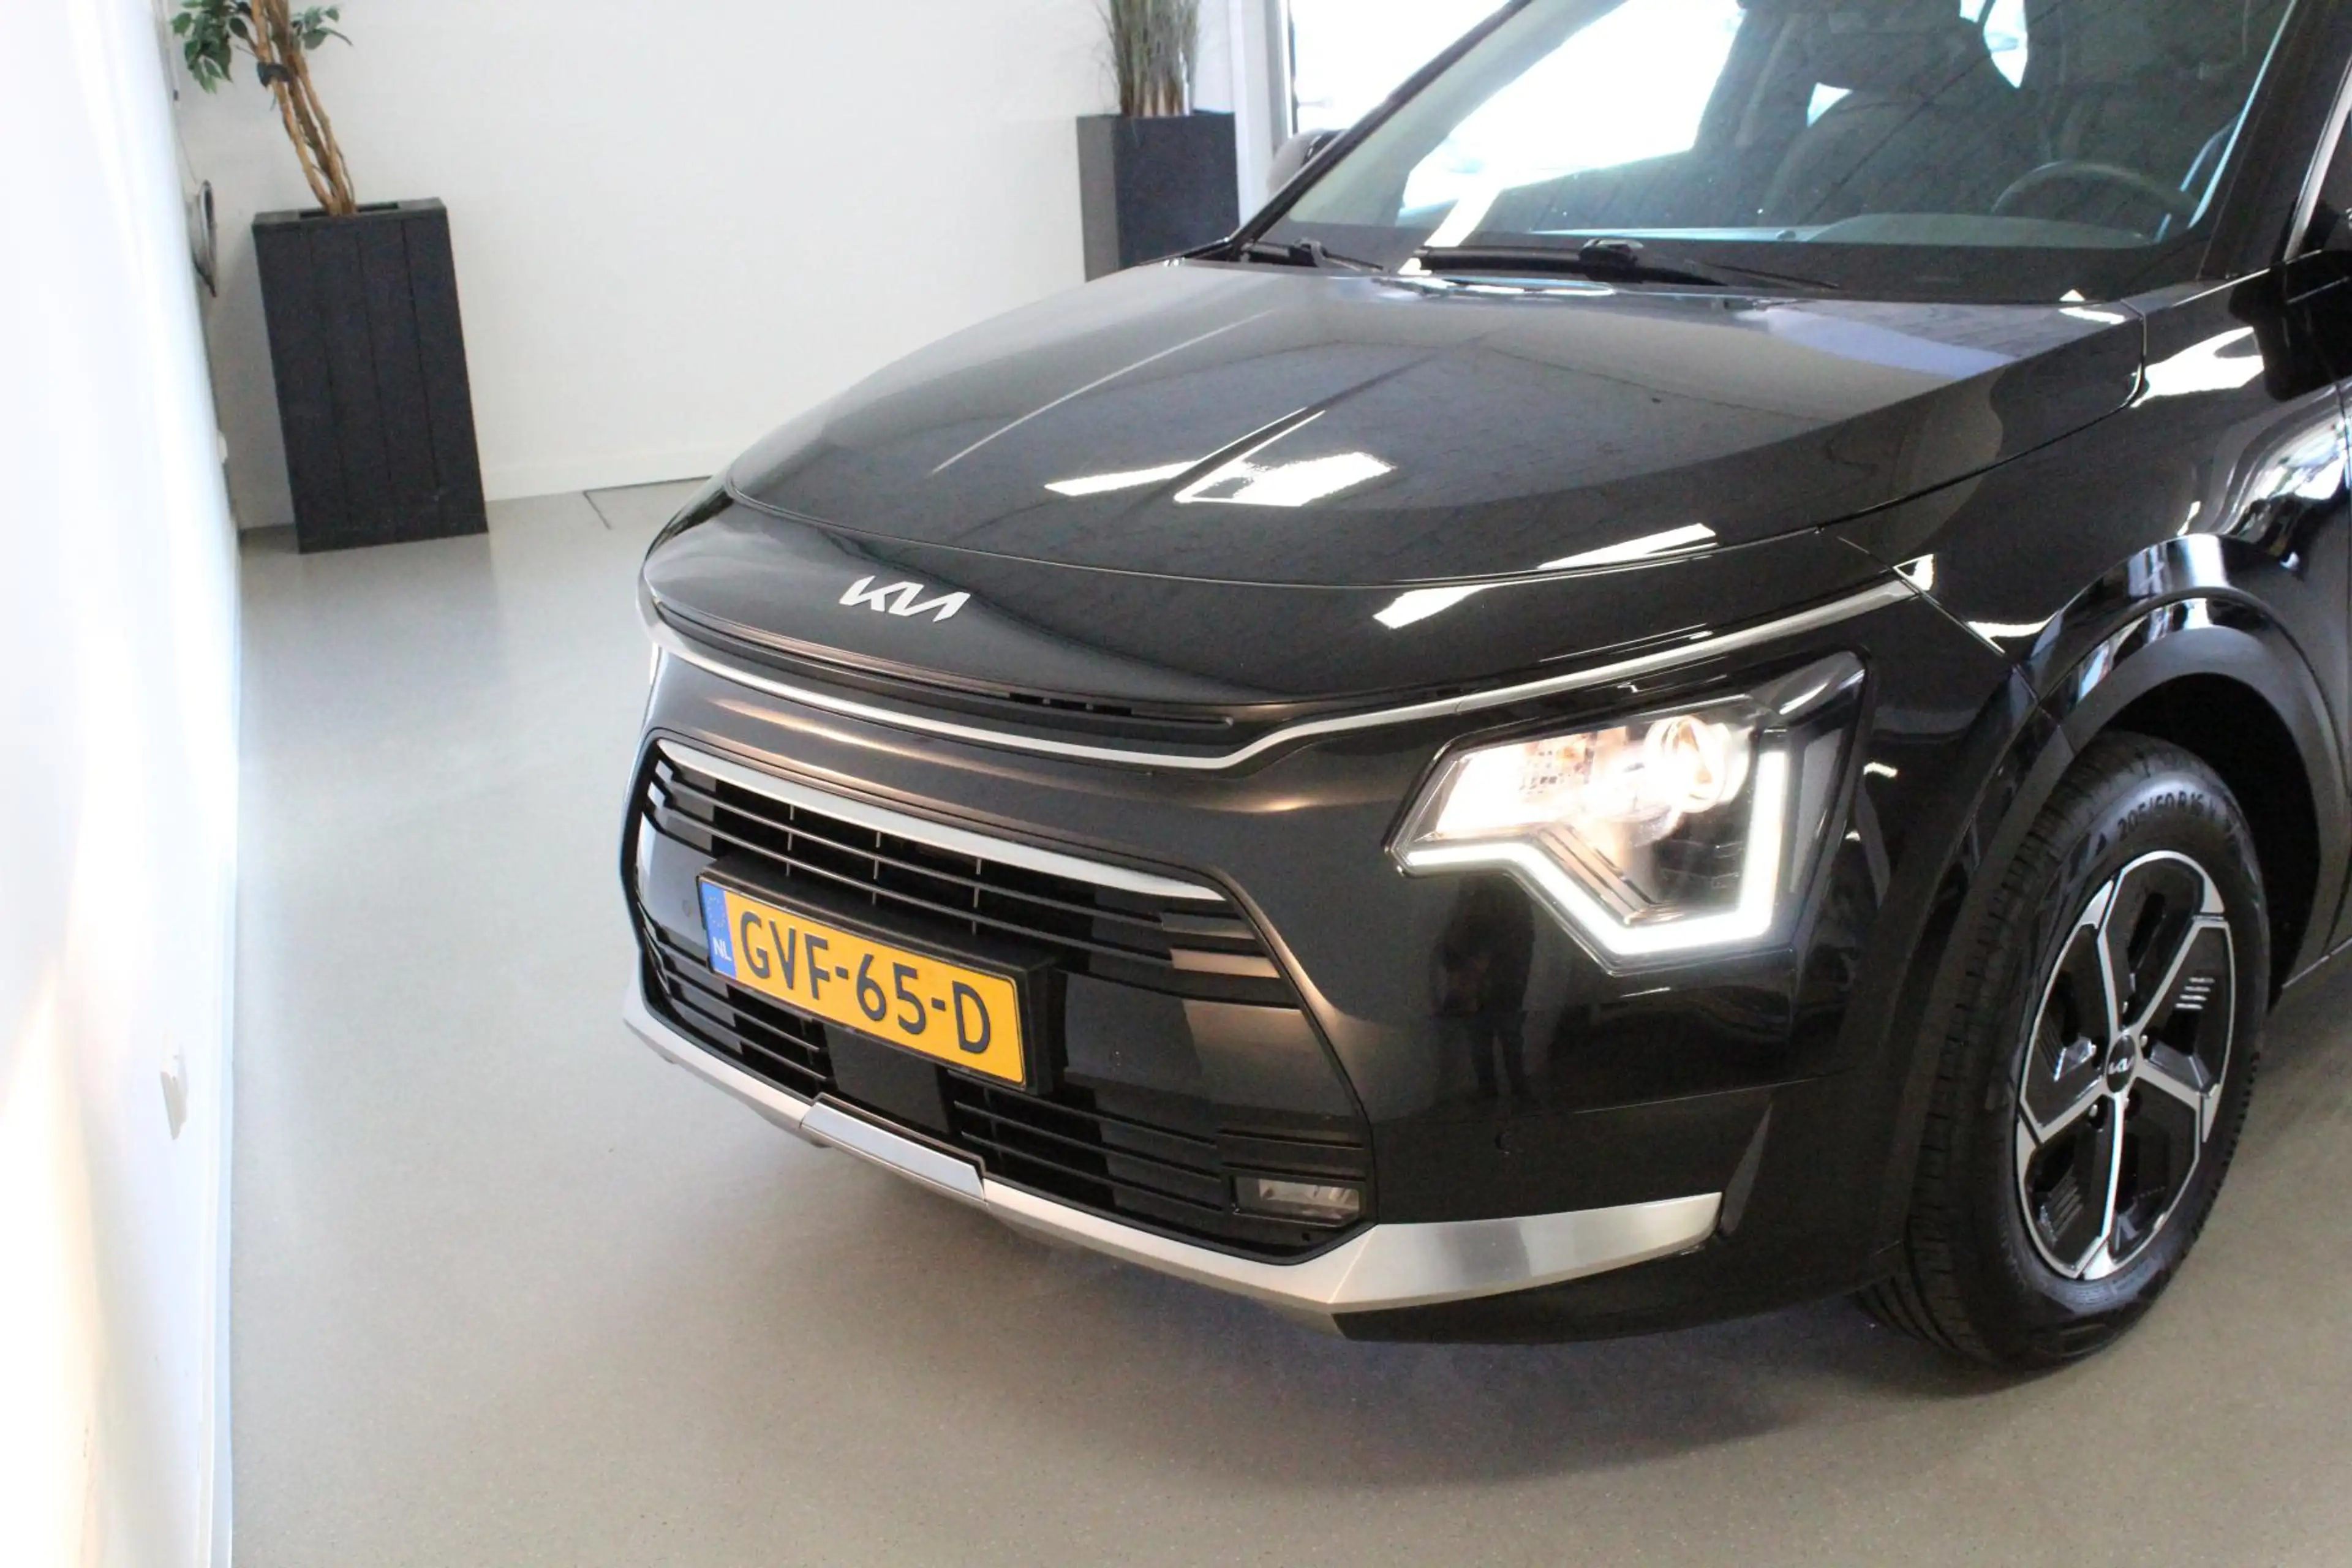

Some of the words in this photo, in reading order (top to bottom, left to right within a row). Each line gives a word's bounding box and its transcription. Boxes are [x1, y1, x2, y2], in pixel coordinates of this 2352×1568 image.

[839, 575, 971, 623] KIA
[712, 937, 732, 962] NL
[740, 911, 991, 1054] GVF-65-D
